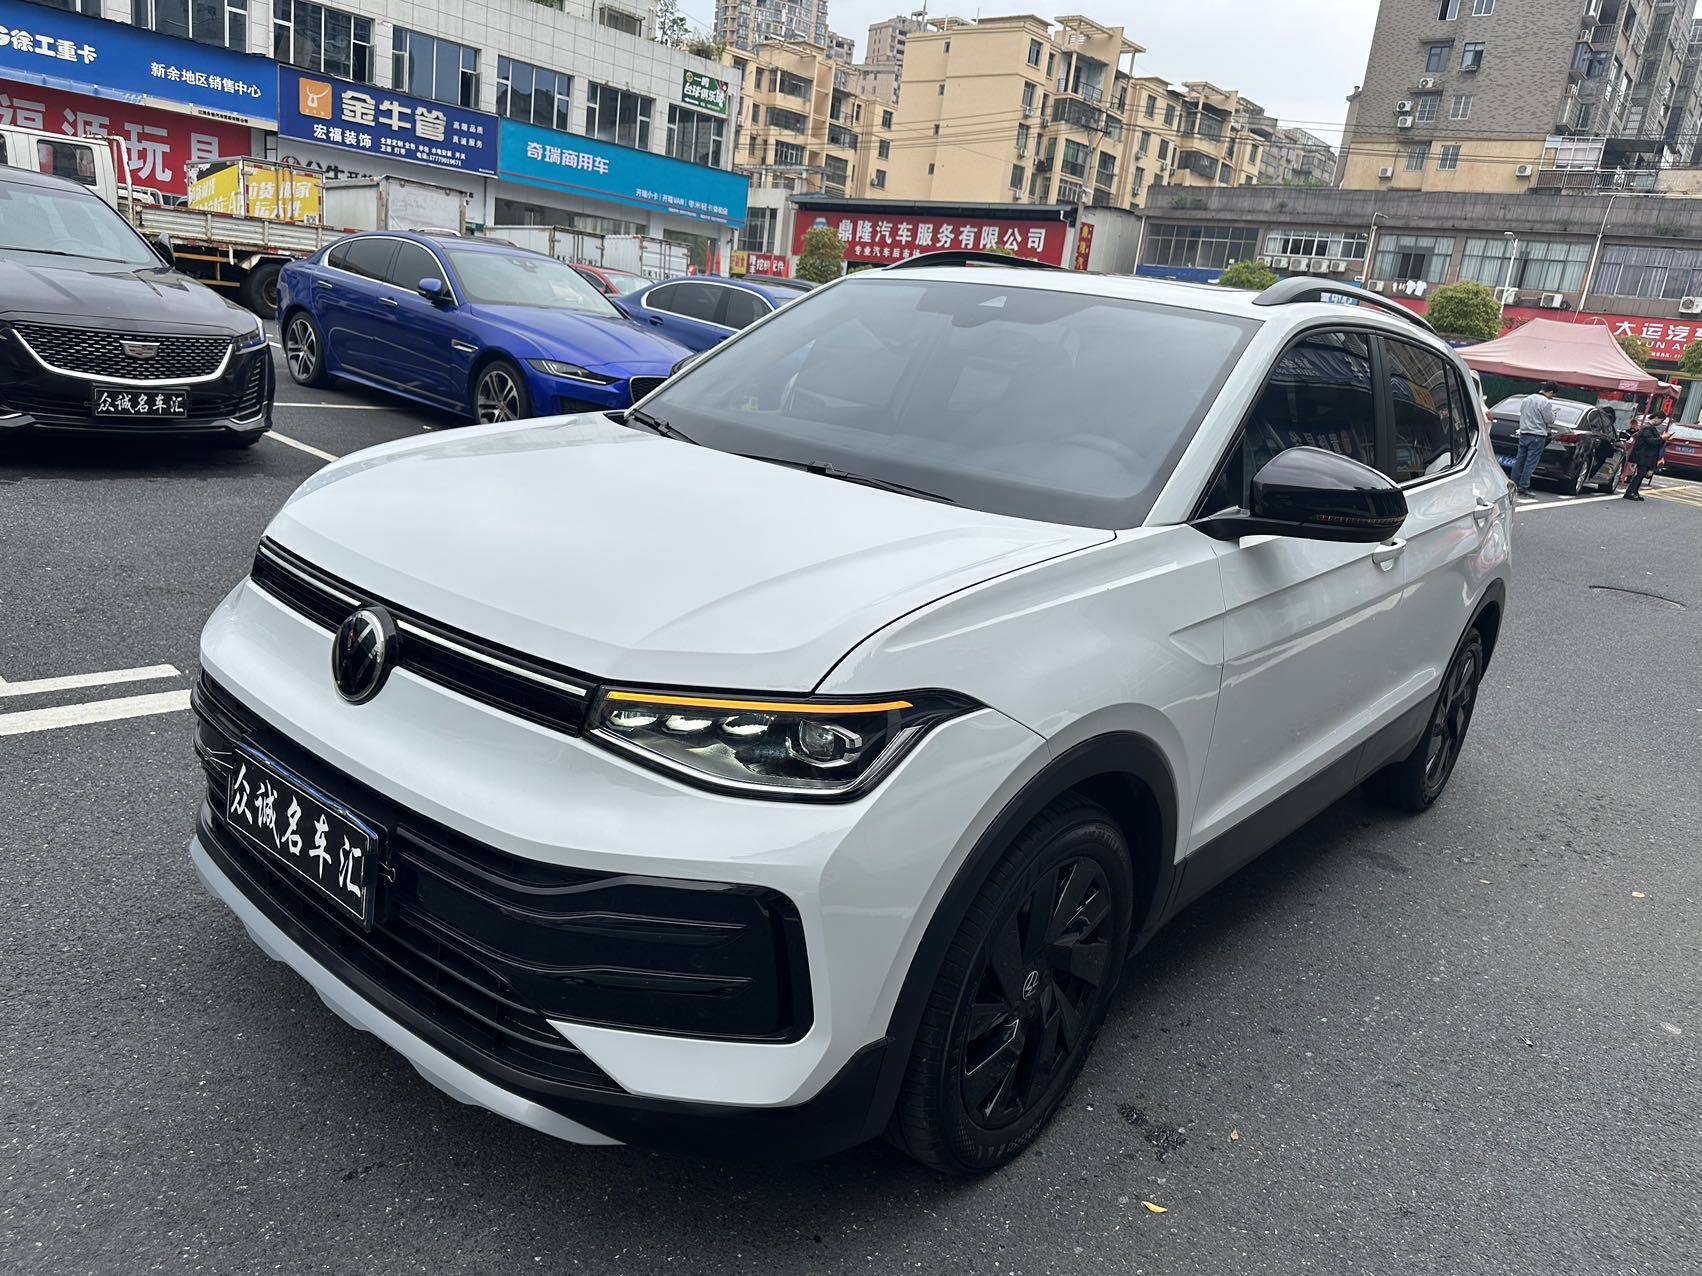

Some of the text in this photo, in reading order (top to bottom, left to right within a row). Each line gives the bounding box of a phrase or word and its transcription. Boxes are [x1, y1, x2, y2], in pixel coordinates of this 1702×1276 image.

[10, 29, 97, 65] 徐工重卡
[150, 62, 261, 98] 新余地区销售中心
[341, 90, 447, 142] 金牛管
[313, 124, 372, 149] 宏福装饰
[452, 135, 483, 149] 真诚服务
[526, 141, 610, 175] 奇瑞商用车
[838, 219, 1046, 253] 鼎隆汽车服务有限公司
[98, 391, 184, 414] 众诚名车汇
[230, 762, 362, 898] 众诚名车汇
